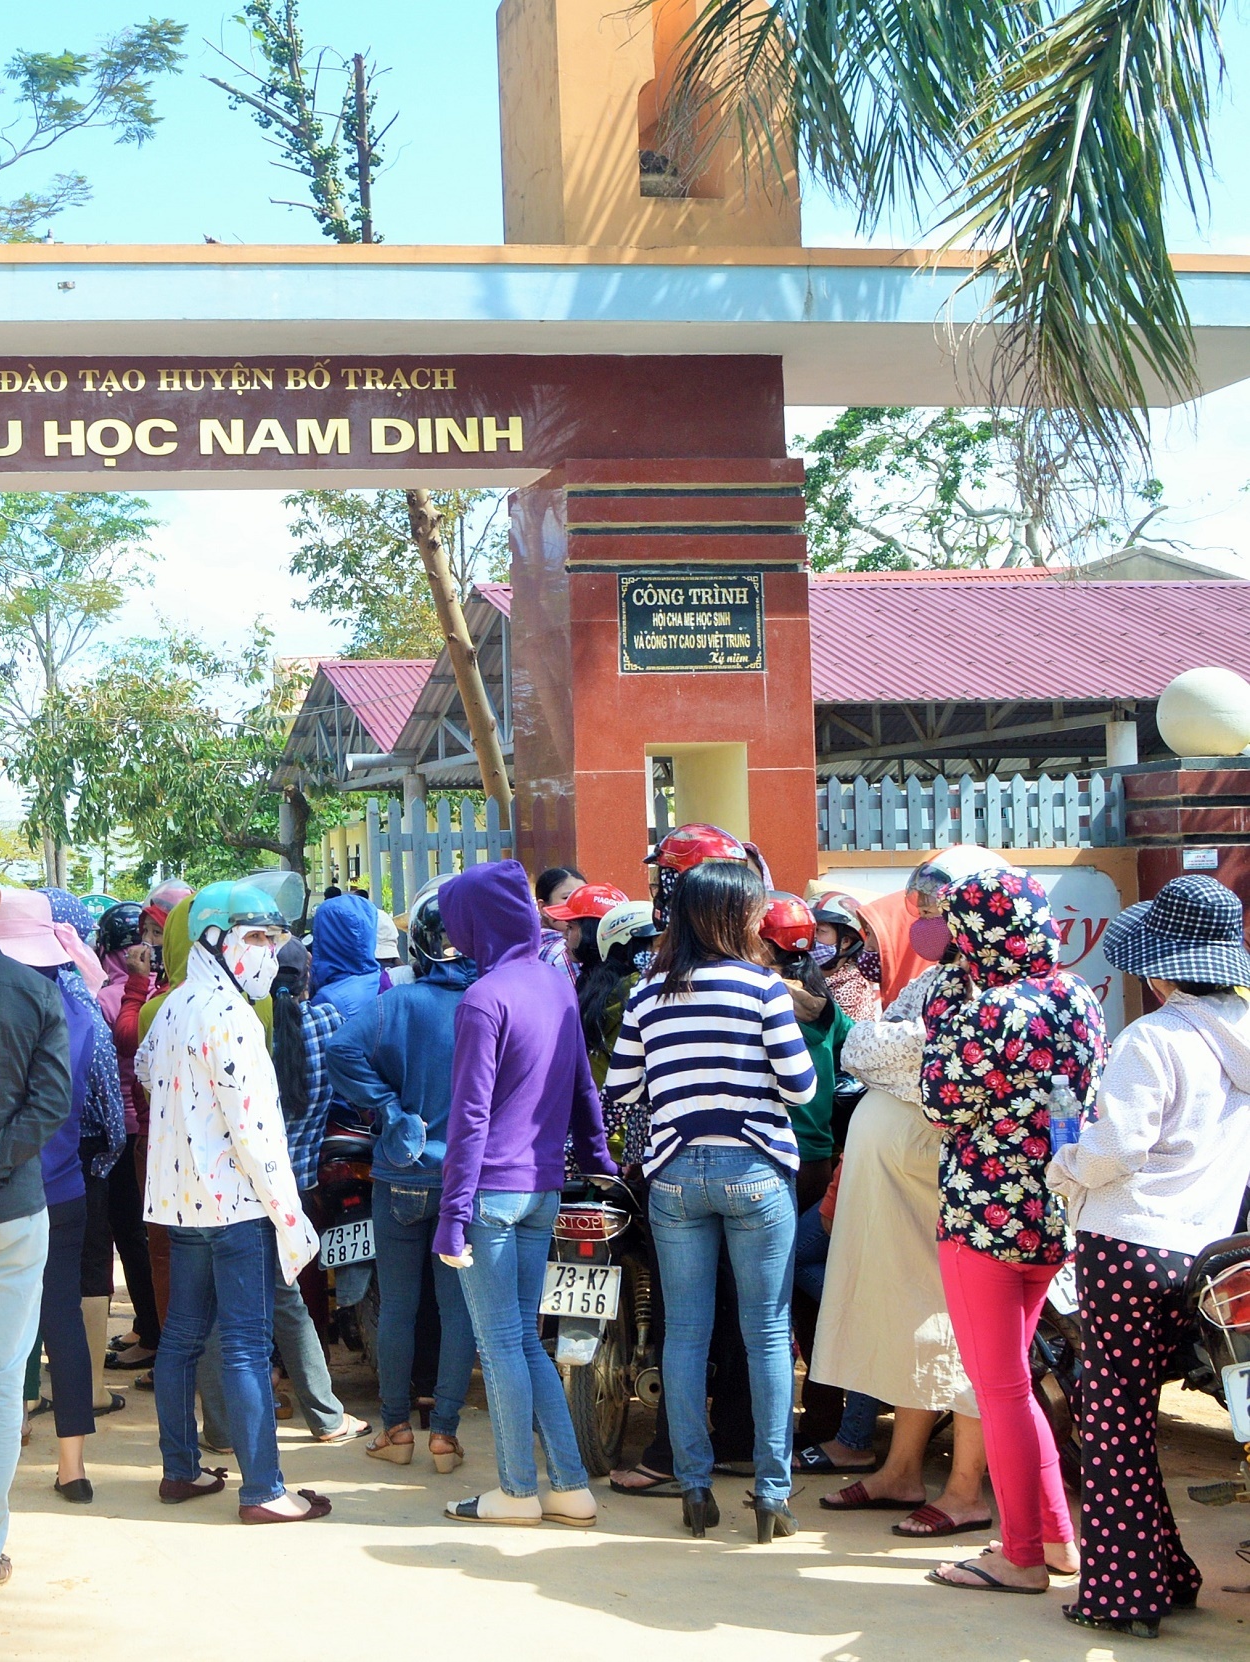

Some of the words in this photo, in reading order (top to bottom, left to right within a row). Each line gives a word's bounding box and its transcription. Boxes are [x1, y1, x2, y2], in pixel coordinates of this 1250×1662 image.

[78, 369, 146, 398] TẠO
[157, 361, 275, 396] HUYỆN
[285, 359, 331, 390] BỐ
[341, 368, 457, 398] TRẠCH
[44, 418, 179, 467] HỌC
[199, 418, 351, 455] NAM
[370, 416, 524, 454] DINH
[632, 584, 685, 606] CÔNG
[689, 584, 749, 605] TRÌNH
[652, 609, 666, 631] HỘI
[666, 612, 683, 627] CHA
[683, 611, 695, 630] MẸ
[695, 612, 712, 630] HỌC
[713, 611, 731, 627] SINH
[633, 631, 645, 650] VÀ
[645, 631, 668, 650] CÔNG
[668, 634, 679, 649] TY
[679, 634, 696, 649] CAO
[696, 633, 707, 649] SU
[708, 631, 724, 652] VIỆT
[724, 633, 751, 649] TRUNG
[327, 1221, 368, 1247] 73-P1
[559, 1215, 602, 1230] STOP
[327, 1239, 370, 1265] 6878
[555, 1265, 610, 1291] 73-K7
[551, 1291, 606, 1315] 3156
